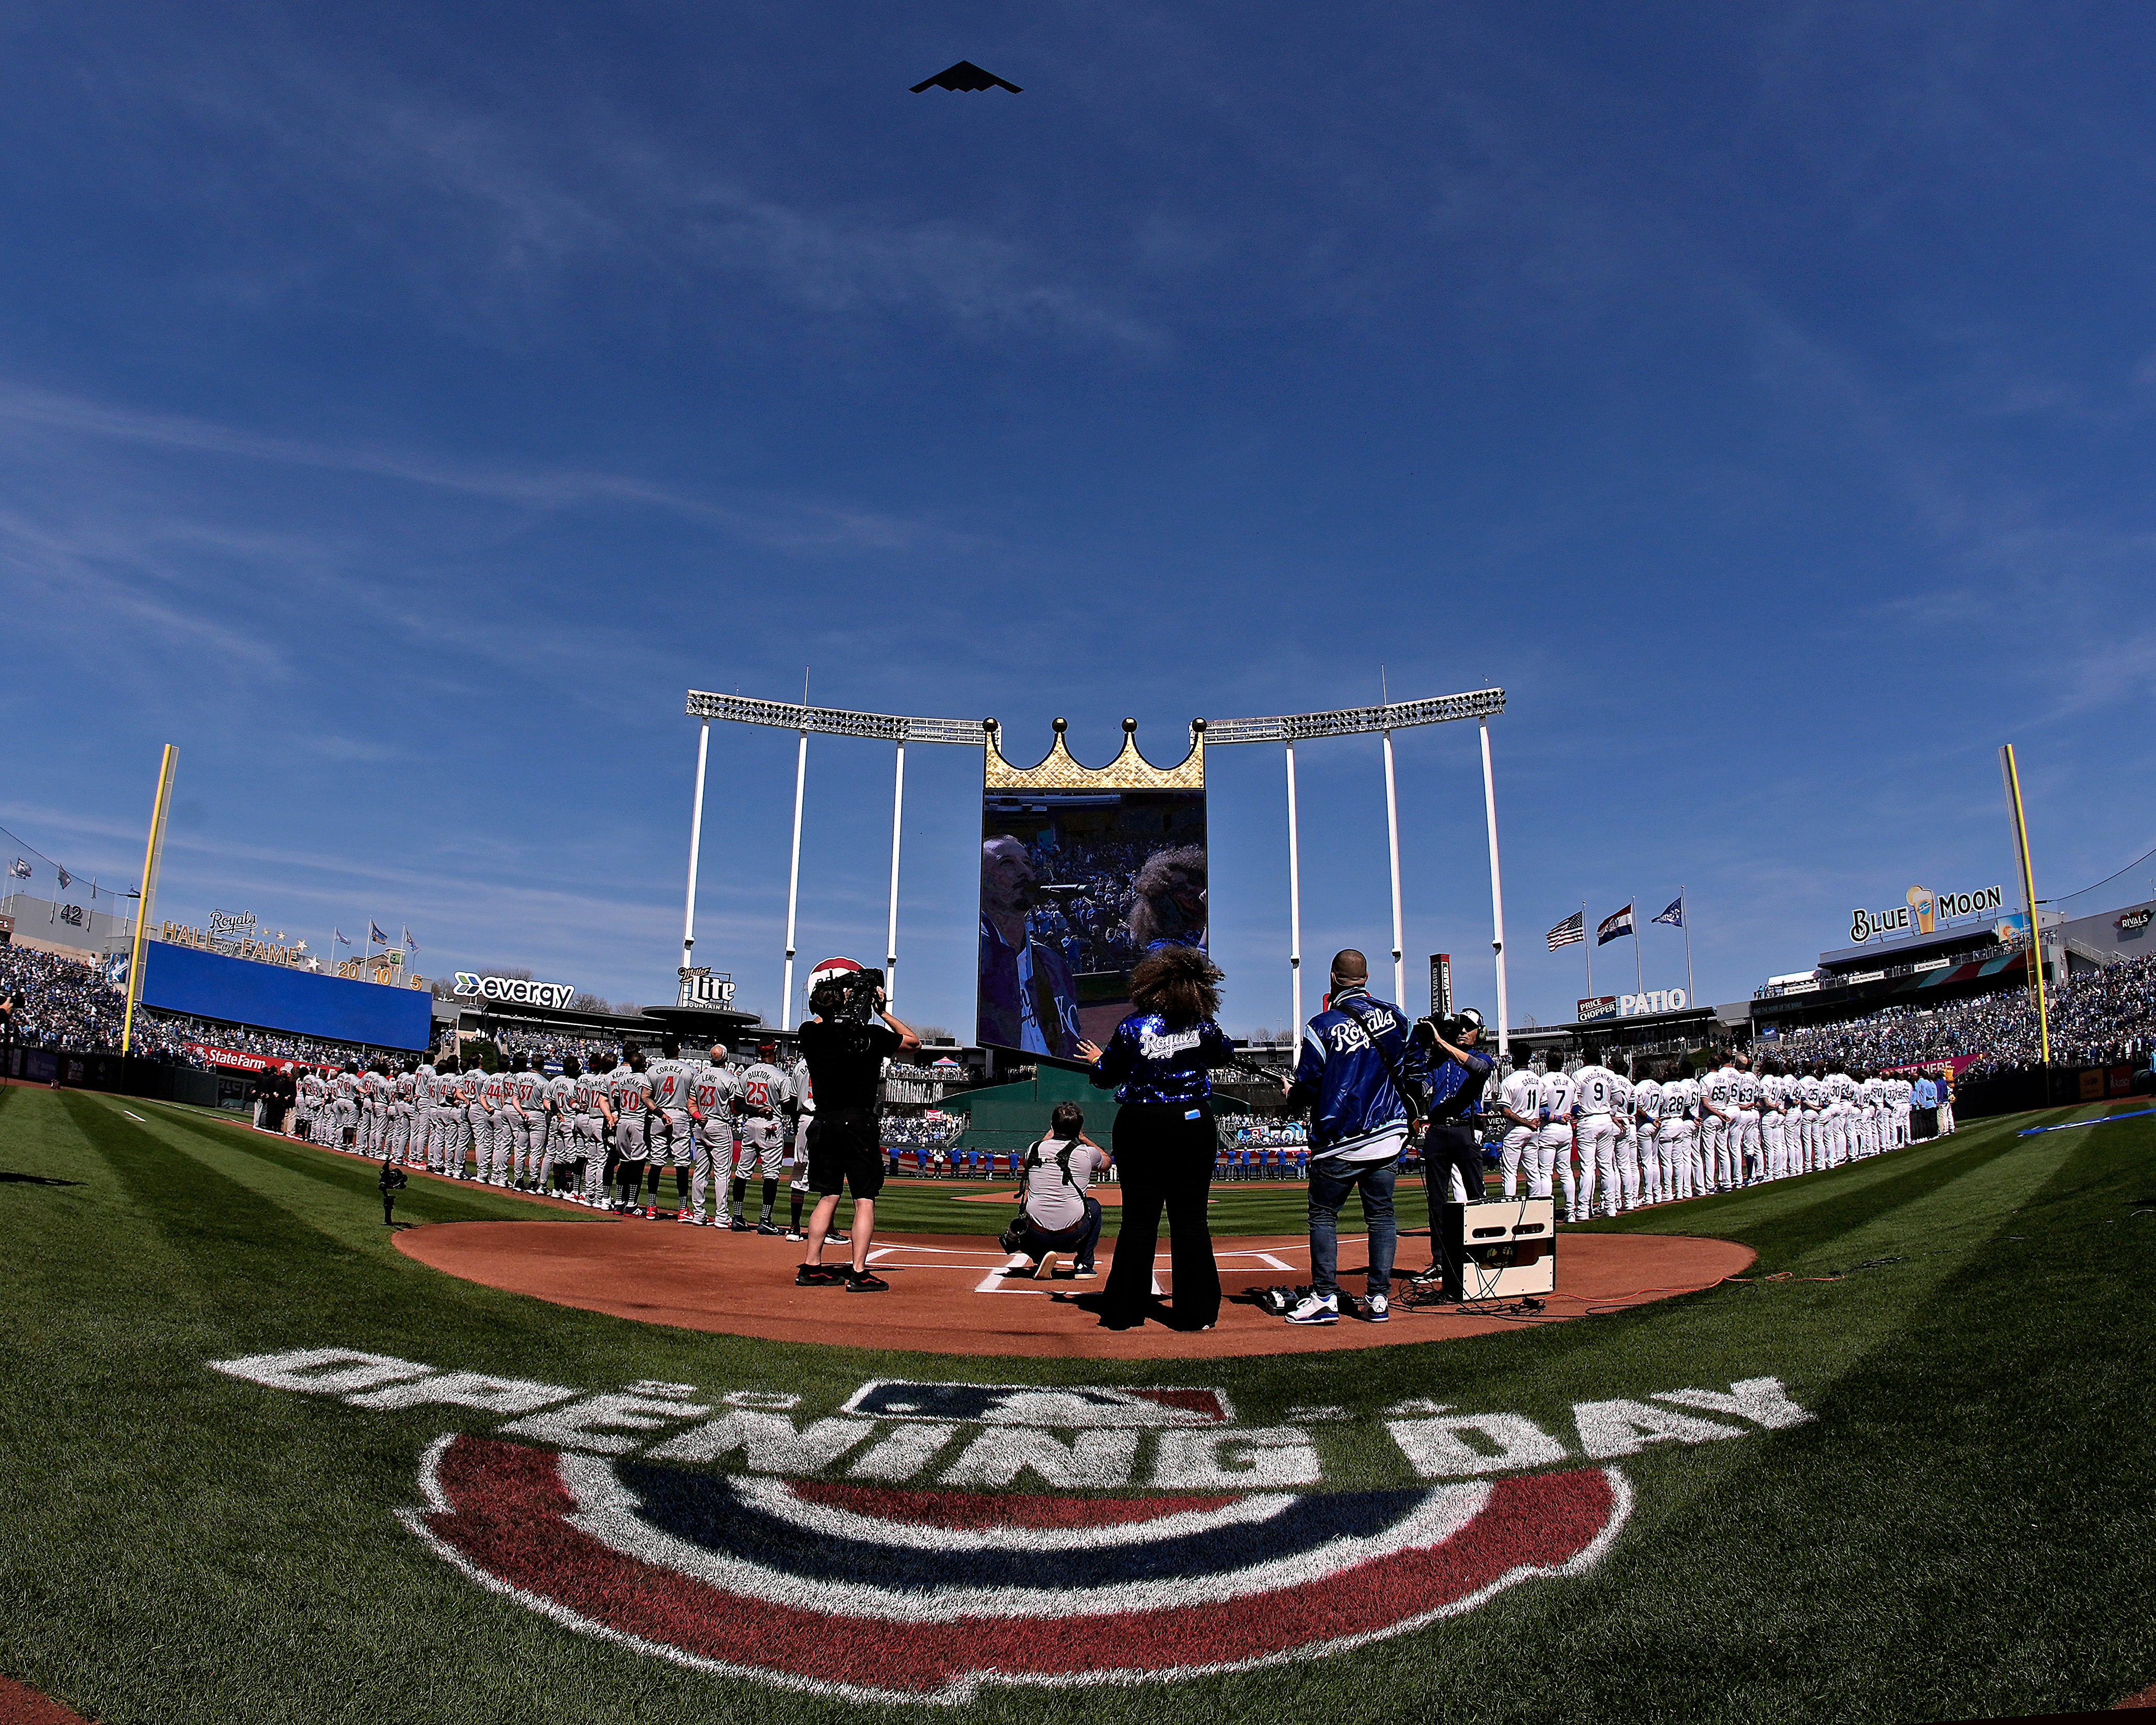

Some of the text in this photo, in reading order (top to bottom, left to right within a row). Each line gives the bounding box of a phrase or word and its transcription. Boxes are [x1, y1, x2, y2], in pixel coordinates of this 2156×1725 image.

[61, 904, 83, 923] 42
[210, 910, 257, 935] Royals
[1850, 885, 2002, 942] BLUE MOON
[2122, 914, 2148, 927] RIVALS
[162, 921, 301, 967] HALL of FAME
[338, 961, 359, 980] 20
[373, 968, 391, 985] 10
[678, 967, 710, 980] Miller
[410, 974, 422, 991] 5
[689, 975, 736, 1004] Lite
[482, 977, 574, 1008] evergy
[1579, 998, 1602, 1011] PRICE
[1620, 988, 1686, 1016] PATIO
[1579, 1004, 1615, 1021] CHOPPER
[1139, 1029, 1201, 1060] Royals
[656, 1065, 683, 1075] CORREA
[747, 1071, 772, 1082] BUXTON
[464, 1080, 476, 1095] 38
[662, 1076, 675, 1096] 4
[1522, 1078, 1539, 1086] GARCIA
[1830, 1085, 1840, 1097] 30
[487, 1085, 501, 1099] 44
[519, 1085, 533, 1101] 37
[621, 1089, 639, 1111] 30
[699, 1085, 716, 1107] 23
[747, 1082, 768, 1105] 25
[1527, 1089, 1536, 1110] 11
[1556, 1090, 1565, 1110] 7
[1594, 1083, 1604, 1101] 9
[1712, 1086, 1727, 1101] 65
[1808, 1088, 1818, 1101] 35
[1668, 1096, 1685, 1112] 28
[207, 1347, 1818, 1489] OPENING DAY
